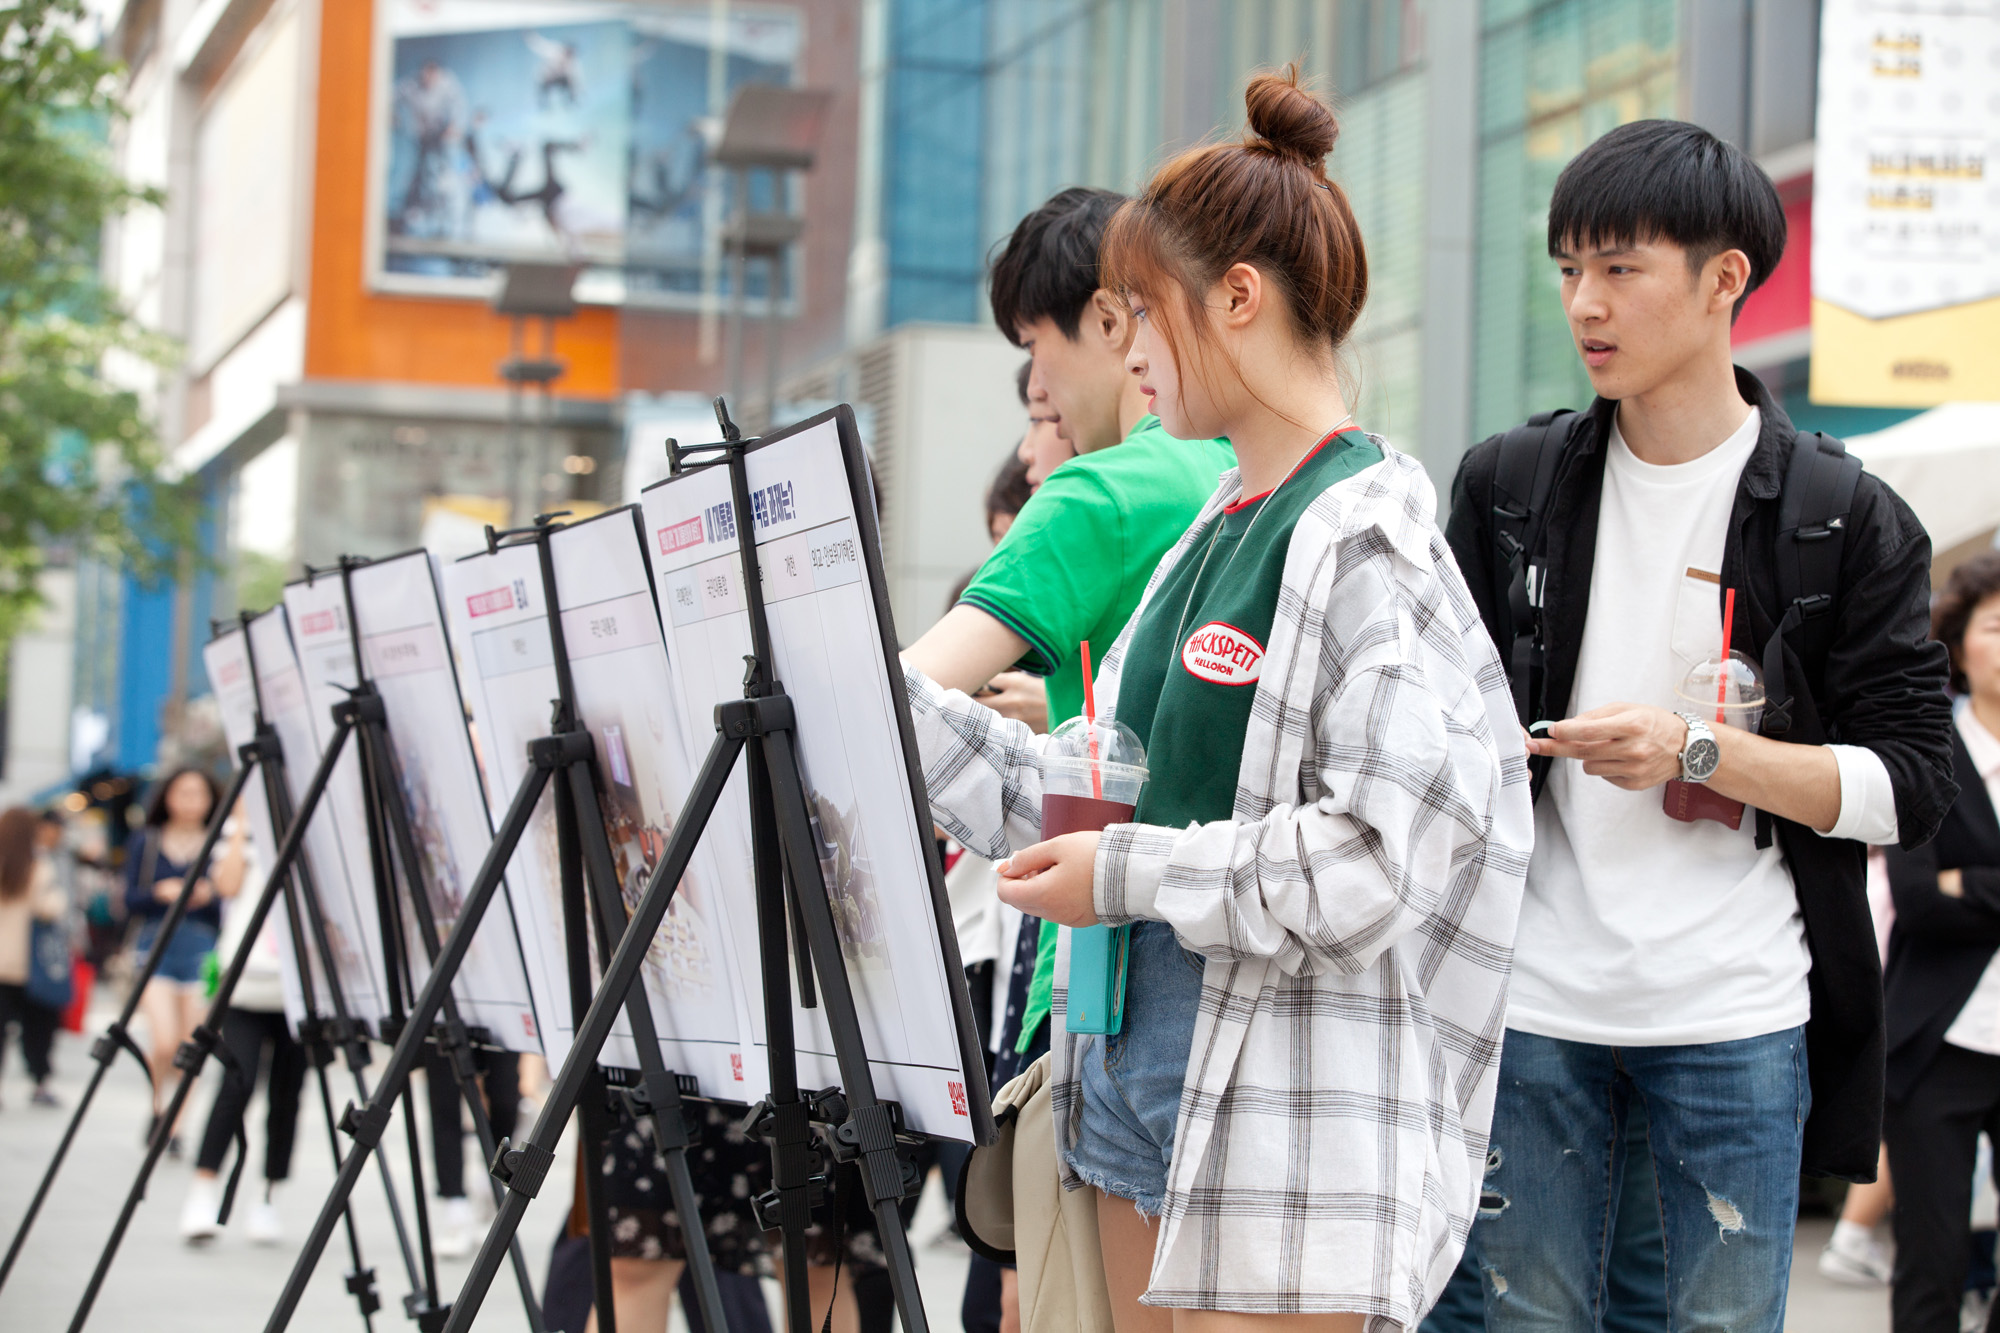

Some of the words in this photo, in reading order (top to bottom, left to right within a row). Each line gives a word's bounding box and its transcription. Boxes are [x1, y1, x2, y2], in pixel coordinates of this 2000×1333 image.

[705, 508, 715, 544] 새
[712, 501, 736, 542] 대통령
[767, 480, 796, 524] 과제는?
[1189, 632, 1261, 672] HACKSPETT
